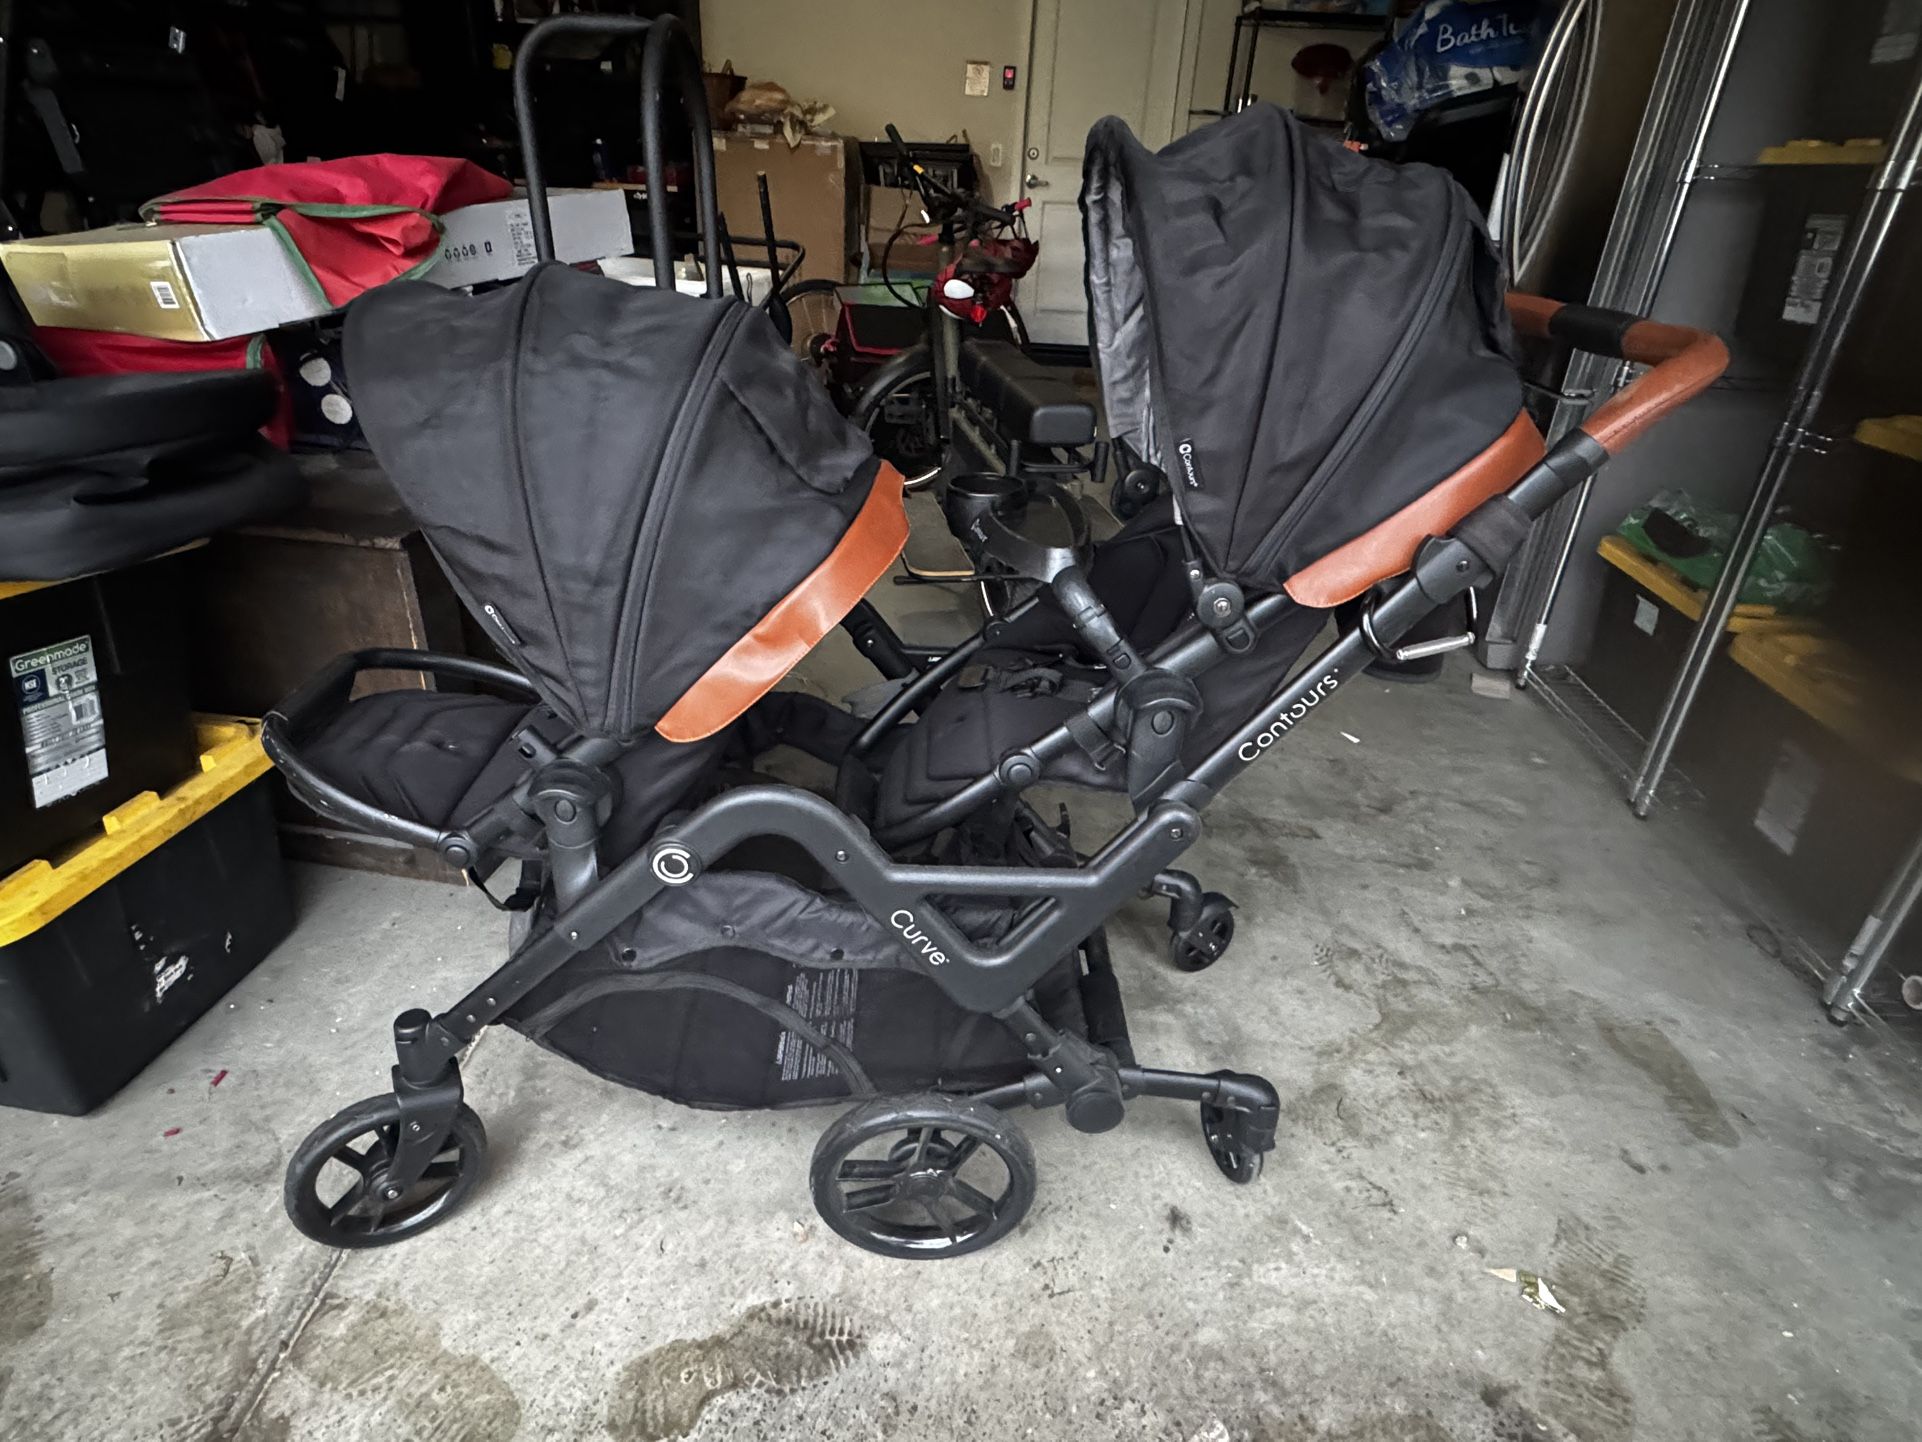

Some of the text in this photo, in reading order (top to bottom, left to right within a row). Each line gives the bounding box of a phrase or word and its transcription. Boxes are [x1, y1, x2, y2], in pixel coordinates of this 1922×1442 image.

[1436, 18, 1498, 53] Bath
[14, 641, 87, 672] Greenmade
[1238, 674, 1339, 761] Contours
[890, 909, 946, 965] Curve
